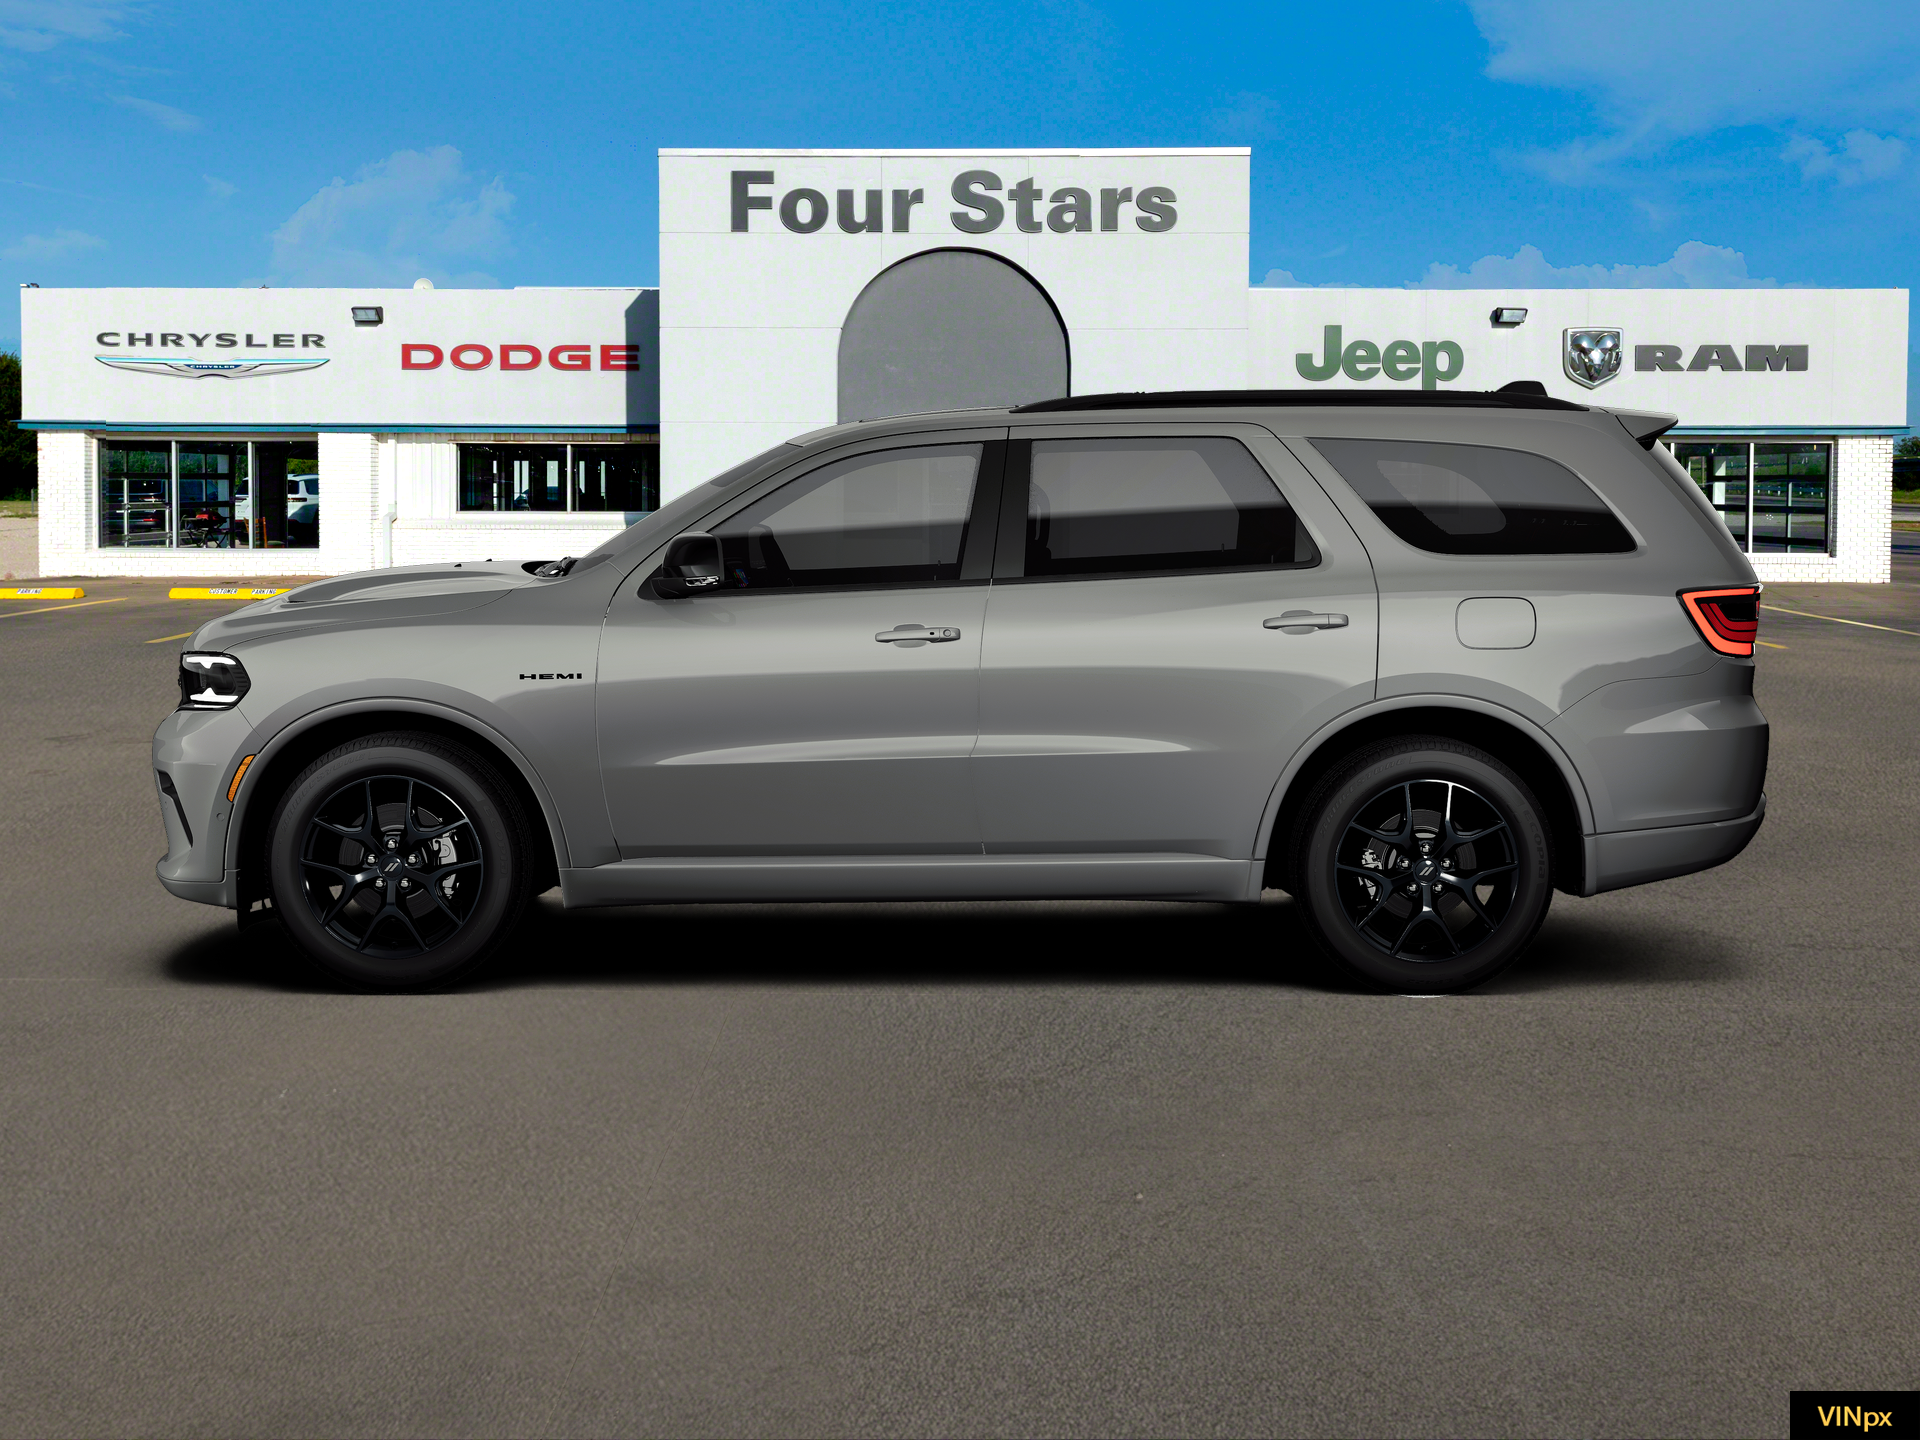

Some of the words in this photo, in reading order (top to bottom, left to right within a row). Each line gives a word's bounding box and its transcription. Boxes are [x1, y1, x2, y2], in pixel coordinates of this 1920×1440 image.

[730, 169, 925, 234] Four
[950, 169, 1178, 234] Stars
[96, 331, 326, 349] CHRYSLER
[401, 343, 640, 371] DODGE
[1295, 324, 1464, 391] Jeep
[1635, 344, 1809, 372] RAM
[519, 672, 583, 680] HEMI
